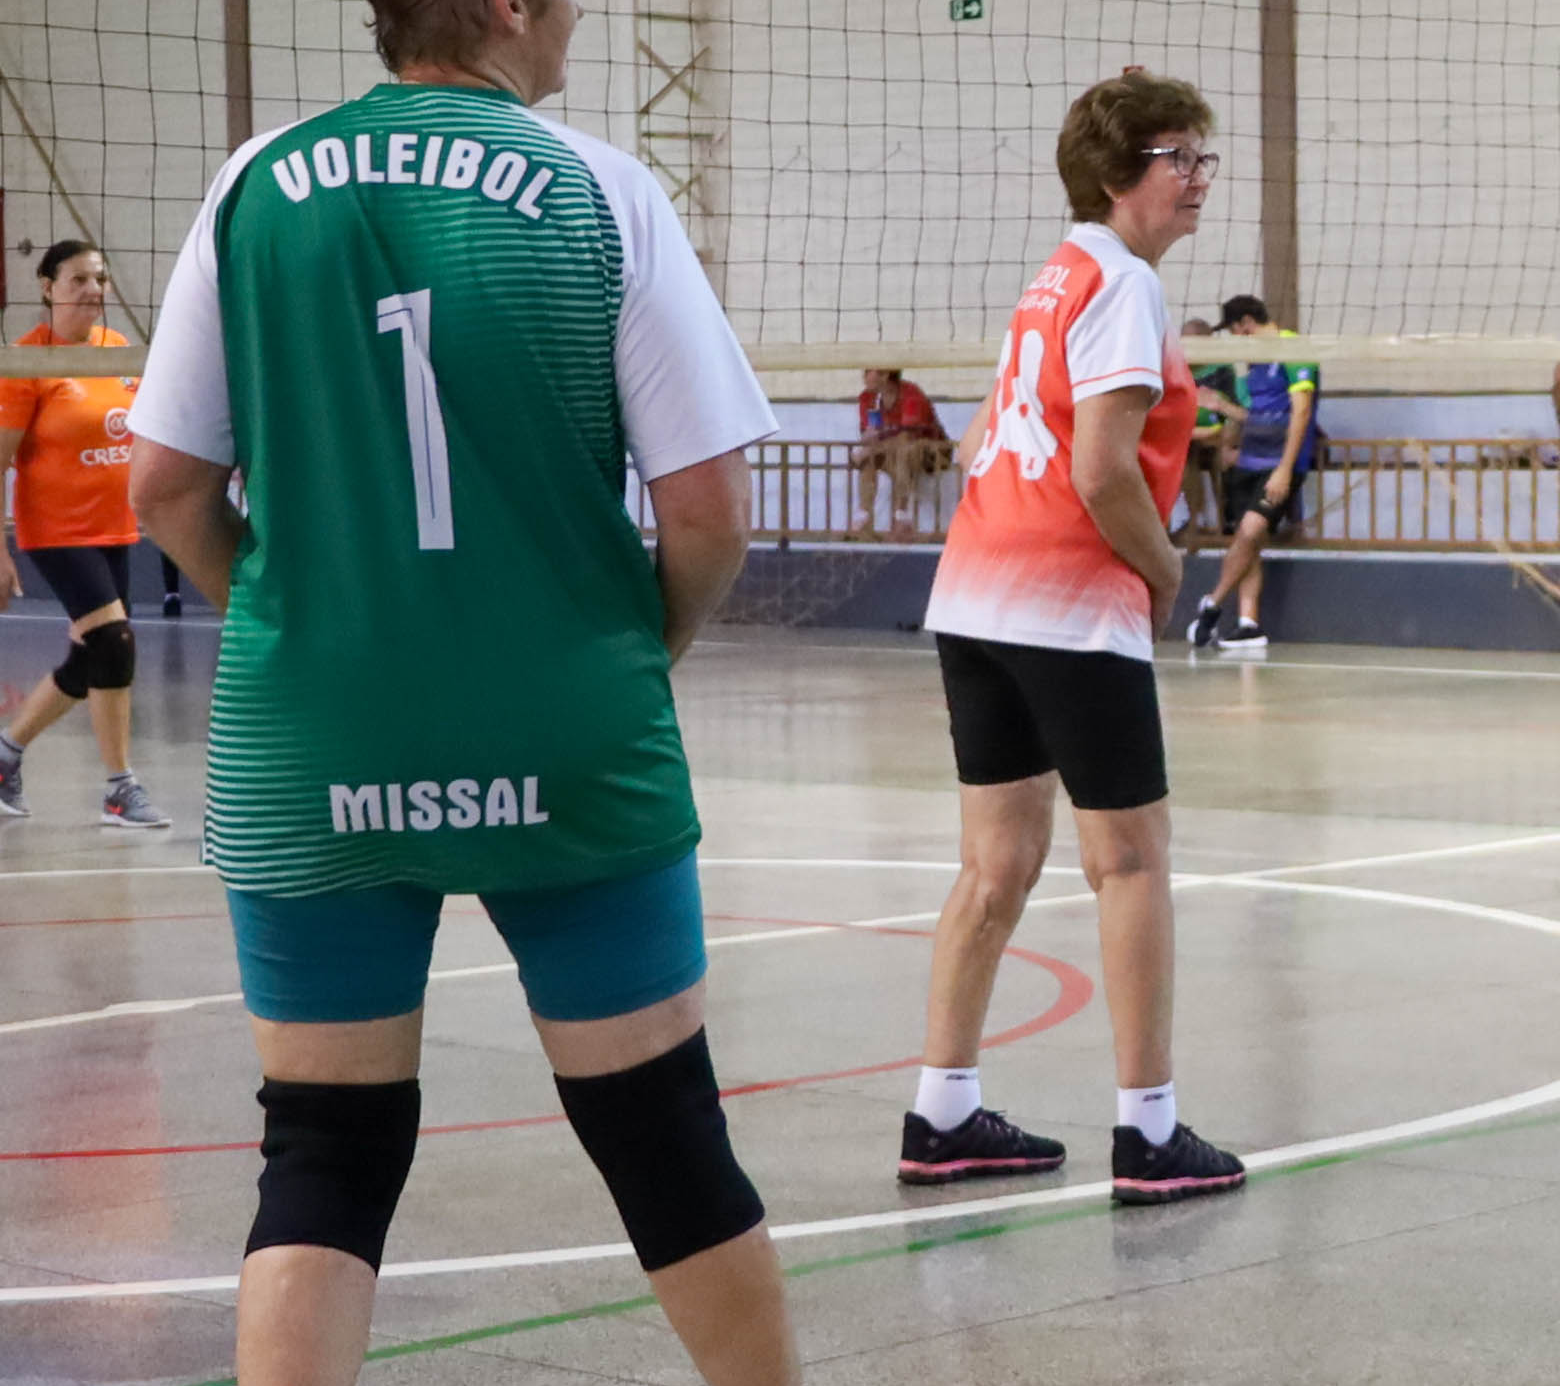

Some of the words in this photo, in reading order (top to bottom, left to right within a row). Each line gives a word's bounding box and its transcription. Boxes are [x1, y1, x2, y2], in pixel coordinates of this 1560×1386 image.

[271, 133, 554, 221] VOLEIBOL
[376, 289, 454, 549] 1
[329, 776, 550, 833] MISSAL
